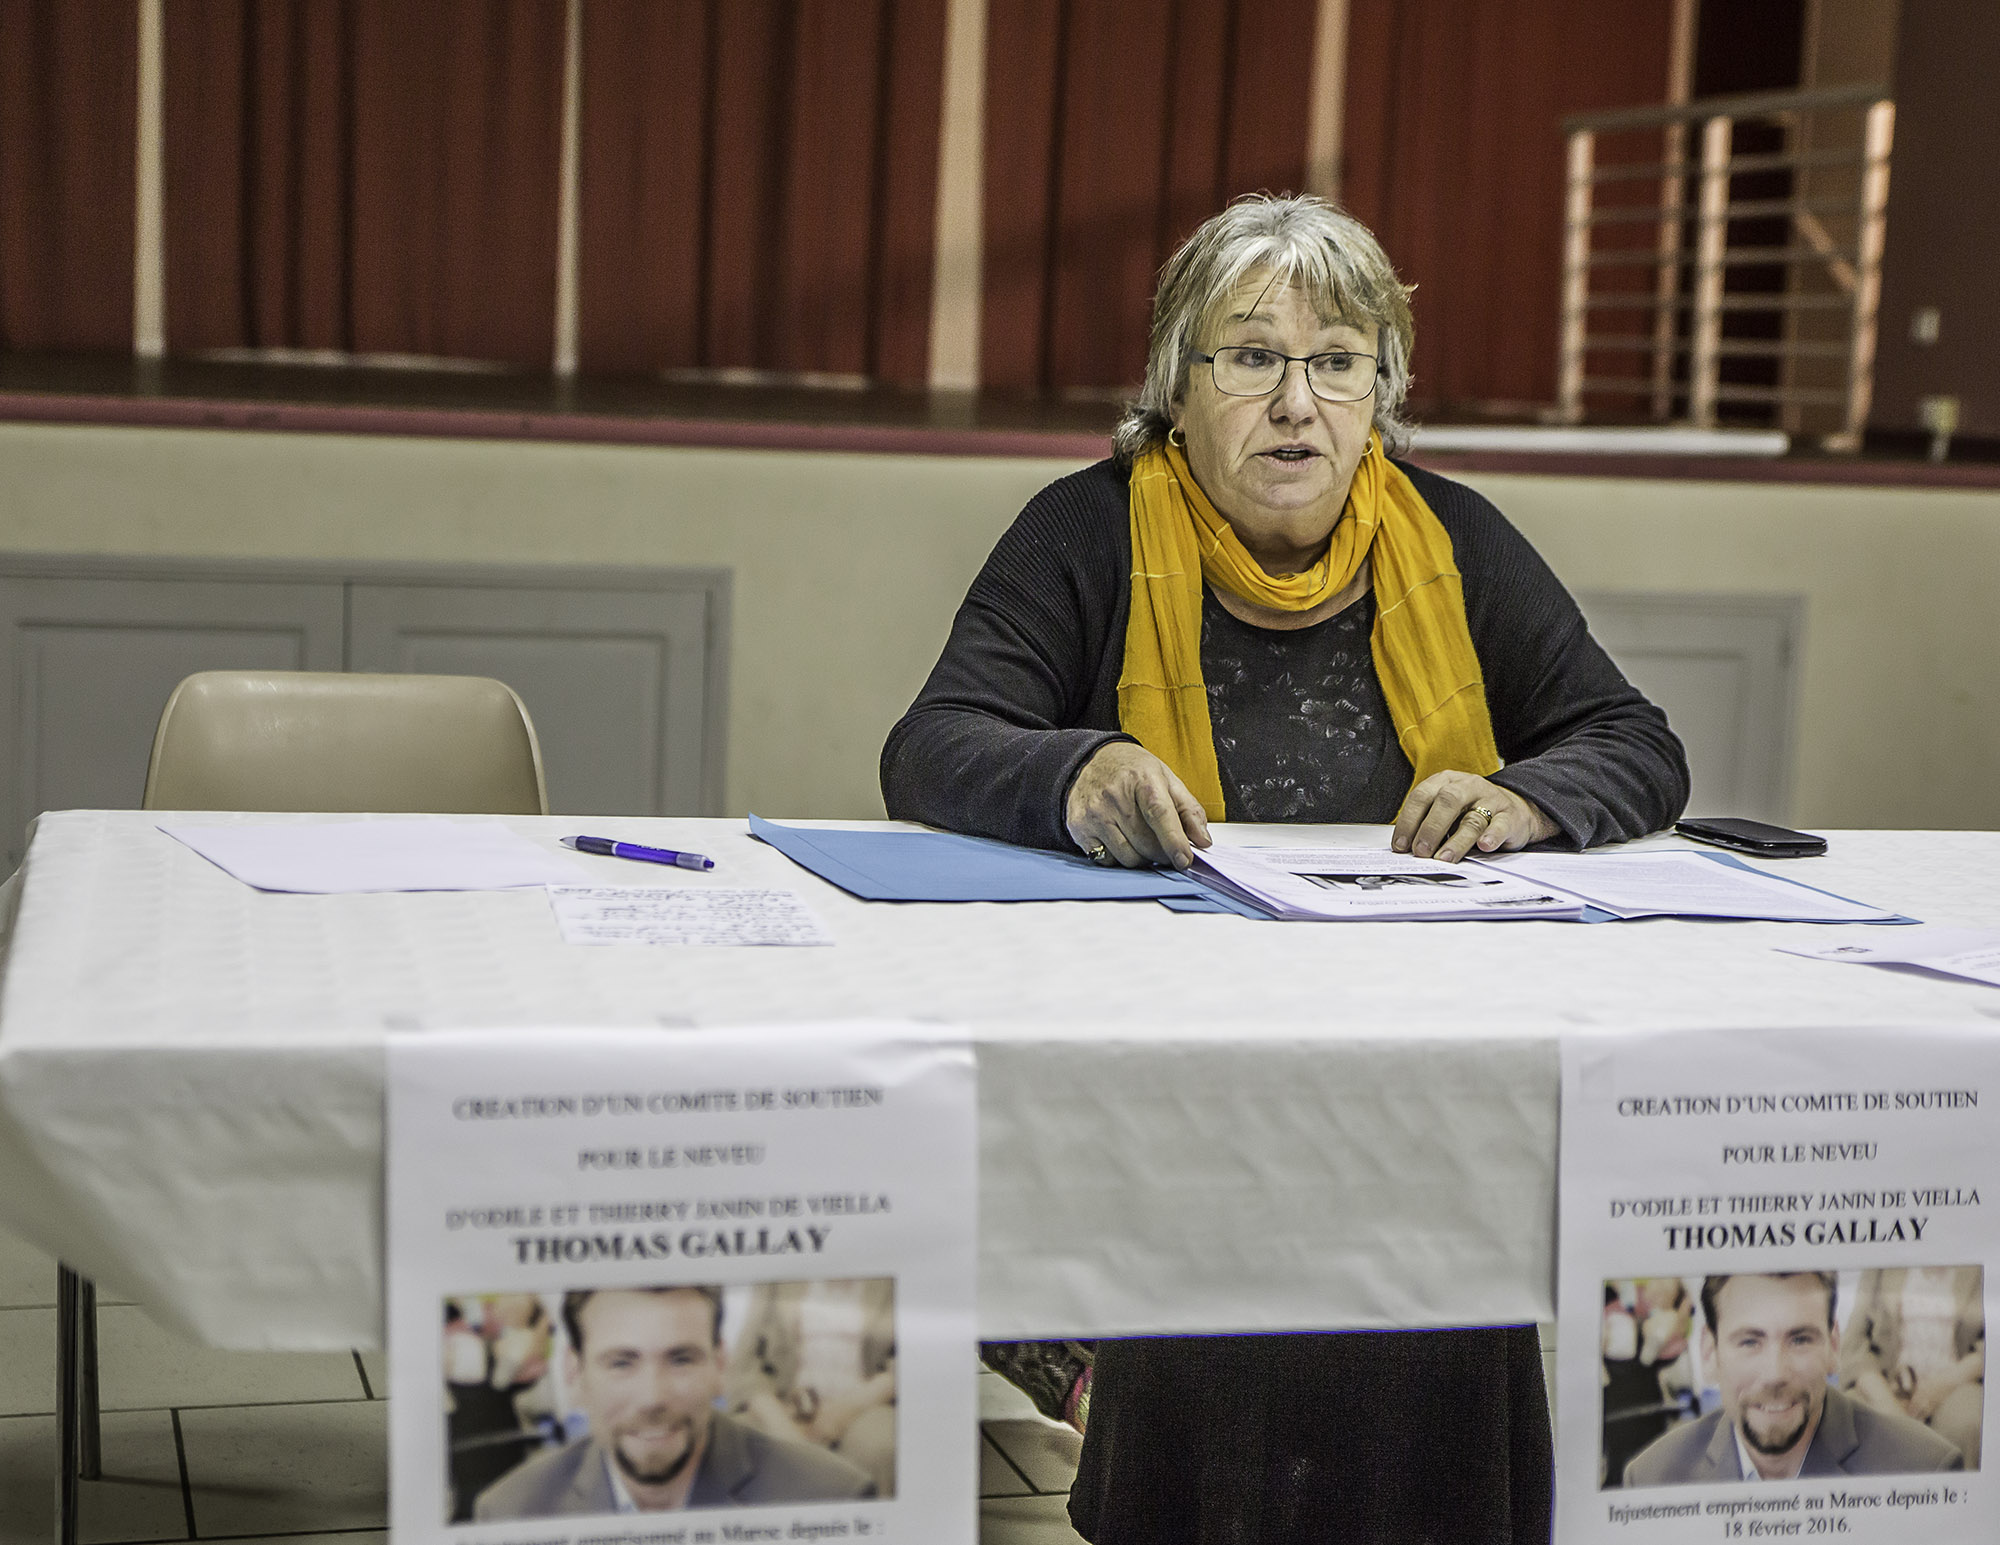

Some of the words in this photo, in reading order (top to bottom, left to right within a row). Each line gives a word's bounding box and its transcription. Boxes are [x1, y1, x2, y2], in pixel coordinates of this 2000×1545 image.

[452, 1097, 576, 1120] CREATION
[646, 1090, 738, 1115] COMITE
[744, 1089, 775, 1111] DE
[780, 1085, 884, 1109] SOUTIEN
[1617, 1094, 1721, 1116] CREATION
[1726, 1095, 1776, 1114] D'UN
[1781, 1092, 1859, 1113] COMITE
[1864, 1092, 1890, 1111] DE
[1894, 1090, 1979, 1110] SOUTIEN
[578, 1149, 643, 1170] POUR
[648, 1147, 679, 1168] LE
[683, 1144, 766, 1167] NEVEU
[1723, 1144, 1775, 1164] POUR
[1781, 1144, 1805, 1162] LE
[1811, 1143, 1878, 1162] NEVEU
[550, 1205, 580, 1226] ET
[769, 1197, 802, 1218] DE
[1610, 1196, 1693, 1218] D'ODILE
[1698, 1197, 1722, 1215] ET
[1730, 1193, 1814, 1214] THIERRY
[1819, 1192, 1876, 1211] JANIN
[1881, 1191, 1907, 1209] DE
[1912, 1189, 1981, 1207] VIELLA
[514, 1234, 670, 1265] THOMAS
[679, 1225, 831, 1258] GALLAY
[1664, 1221, 1796, 1251] THOMAS
[1804, 1217, 1929, 1245] GALLAY
[1608, 1500, 1701, 1524] Injustement
[1706, 1494, 1800, 1518] emprisonné
[1805, 1497, 1824, 1509] au
[1830, 1491, 1882, 1508] Maroc
[1887, 1488, 1938, 1511] depuis
[1942, 1487, 1958, 1504] le
[1724, 1520, 1743, 1538] 18
[1748, 1519, 1801, 1537] février
[1807, 1517, 1852, 1535] 2016.
